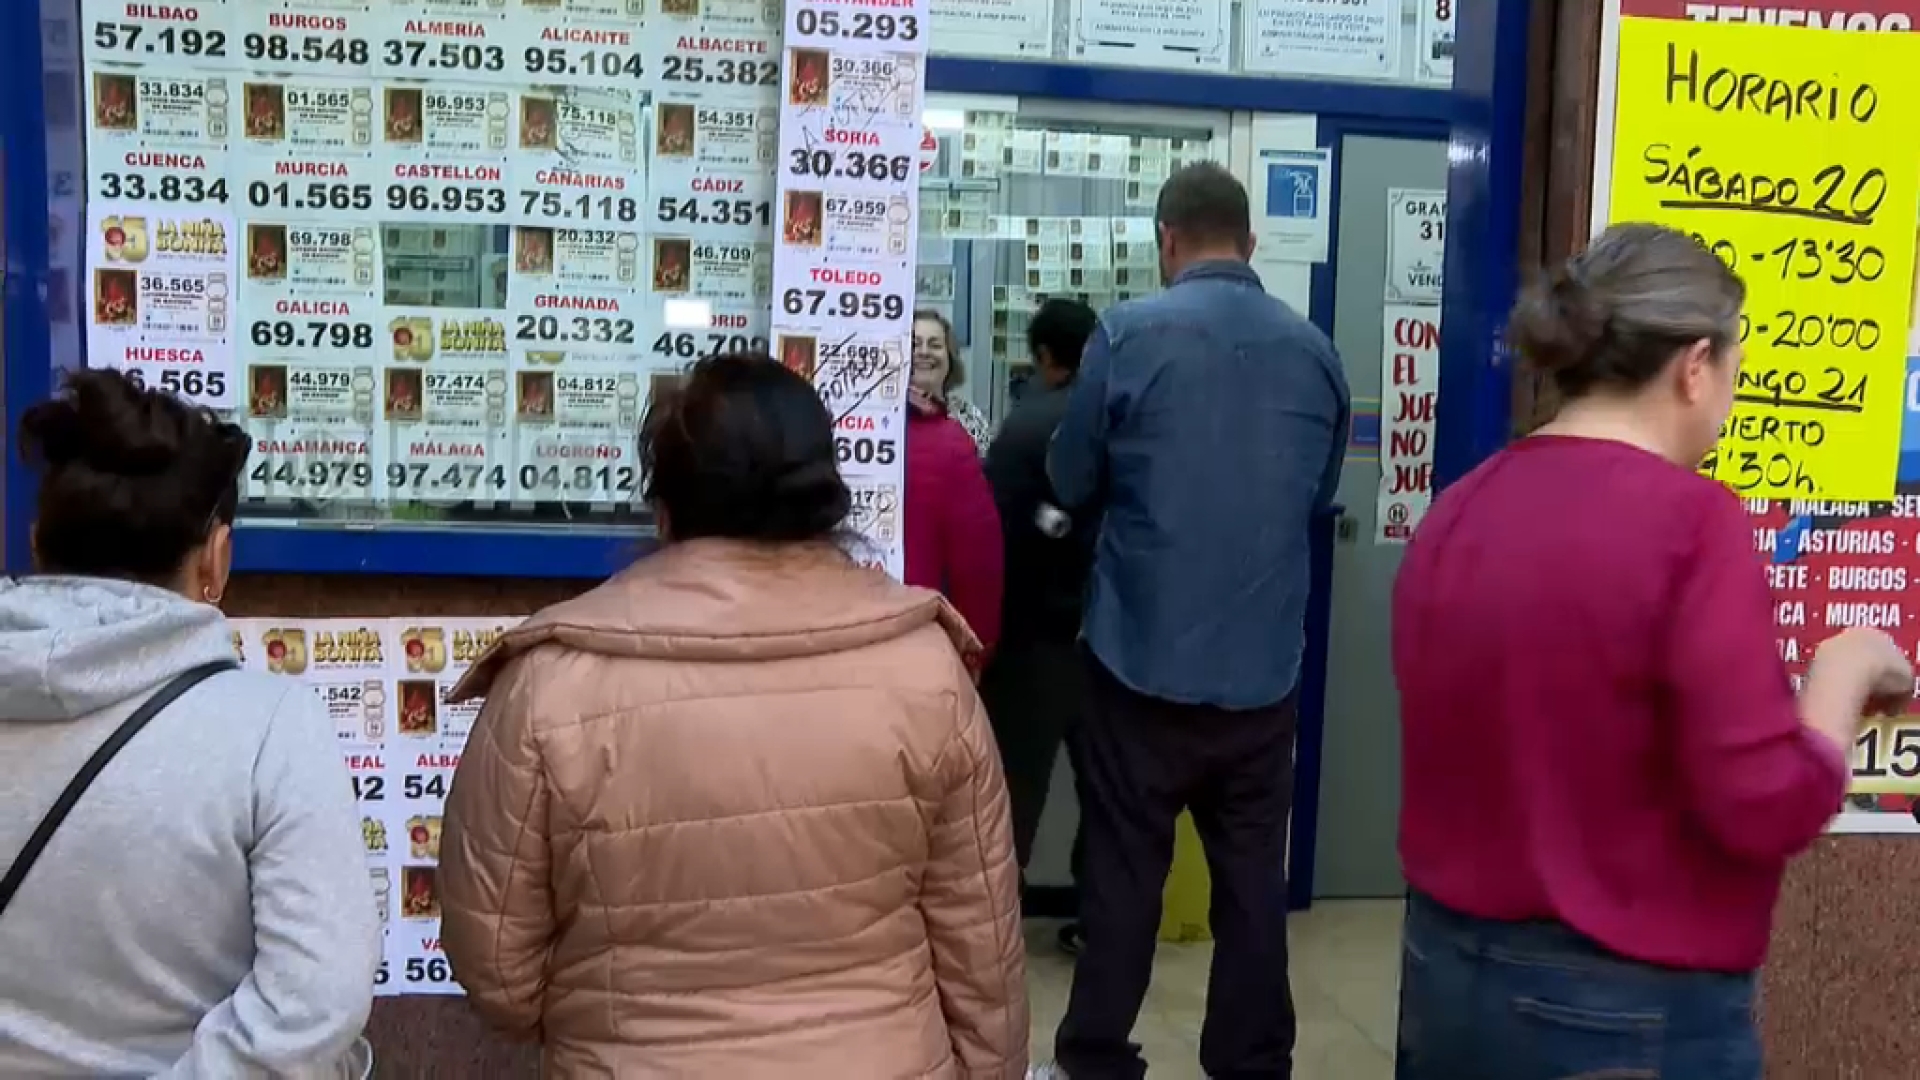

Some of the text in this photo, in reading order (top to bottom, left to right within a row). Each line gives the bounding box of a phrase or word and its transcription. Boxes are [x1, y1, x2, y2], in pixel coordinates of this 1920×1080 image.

[125, 3, 199, 23] BILBAO
[268, 13, 348, 32] BURGOS
[404, 20, 486, 38] ALMERÍA
[796, 9, 919, 41] 05.293
[94, 22, 227, 58] 57.192
[540, 27, 631, 46] ALICANTE
[676, 36, 768, 55] ALBACETE
[243, 33, 370, 66] 98.548
[383, 40, 506, 72] 37.503
[523, 47, 644, 80] 95.104
[661, 55, 779, 87] 25.382
[140, 82, 204, 99] 33.834
[287, 91, 350, 108] 01.565
[425, 95, 486, 112] 96.953
[560, 105, 617, 126] 75.118
[698, 110, 755, 127] 54.351
[824, 129, 881, 147] SORIA
[125, 152, 206, 171] CUENCA
[275, 161, 349, 177] MURCIA
[789, 149, 911, 182] 30.366
[394, 164, 502, 181] CASTELLÓN
[535, 169, 626, 191] CANARIAS
[1643, 144, 1889, 220] SÁBADO 20
[100, 173, 230, 204] 33.834
[248, 181, 373, 210] 01.565
[691, 177, 745, 194] CÁDIZ
[386, 184, 507, 214] 96.953
[520, 190, 637, 223] 75.118
[826, 198, 886, 216] 67.959
[657, 197, 771, 227] 54.351
[290, 232, 352, 247] 69.798
[557, 228, 616, 246] 20.332
[693, 246, 752, 263] 46.709
[140, 277, 205, 294] 36.565
[810, 268, 882, 287] TOLEDO
[275, 300, 350, 317] GALICIA
[534, 294, 620, 312] GRANADA
[783, 288, 904, 320] 67.959
[250, 321, 374, 349] 69.798
[516, 315, 635, 345] 20.332
[125, 347, 205, 363] HUESCA
[290, 371, 352, 388] 44.979
[1392, 354, 1420, 387] EL
[122, 368, 226, 397] 6.565
[425, 374, 485, 389] 97.474
[557, 376, 616, 393] 04.812
[1816, 366, 1868, 405] 21
[257, 440, 370, 456] SALAMANCA
[410, 440, 485, 458] MÁLAGA
[1390, 429, 1427, 459] NO
[250, 461, 374, 489] 44.979
[386, 462, 507, 490] 97.474
[519, 464, 637, 492] 04.812
[1798, 529, 1896, 554] ASTURIAS
[1828, 566, 1907, 591] BURGOS
[1825, 603, 1902, 628] MURCIA
[345, 755, 386, 769] EAL
